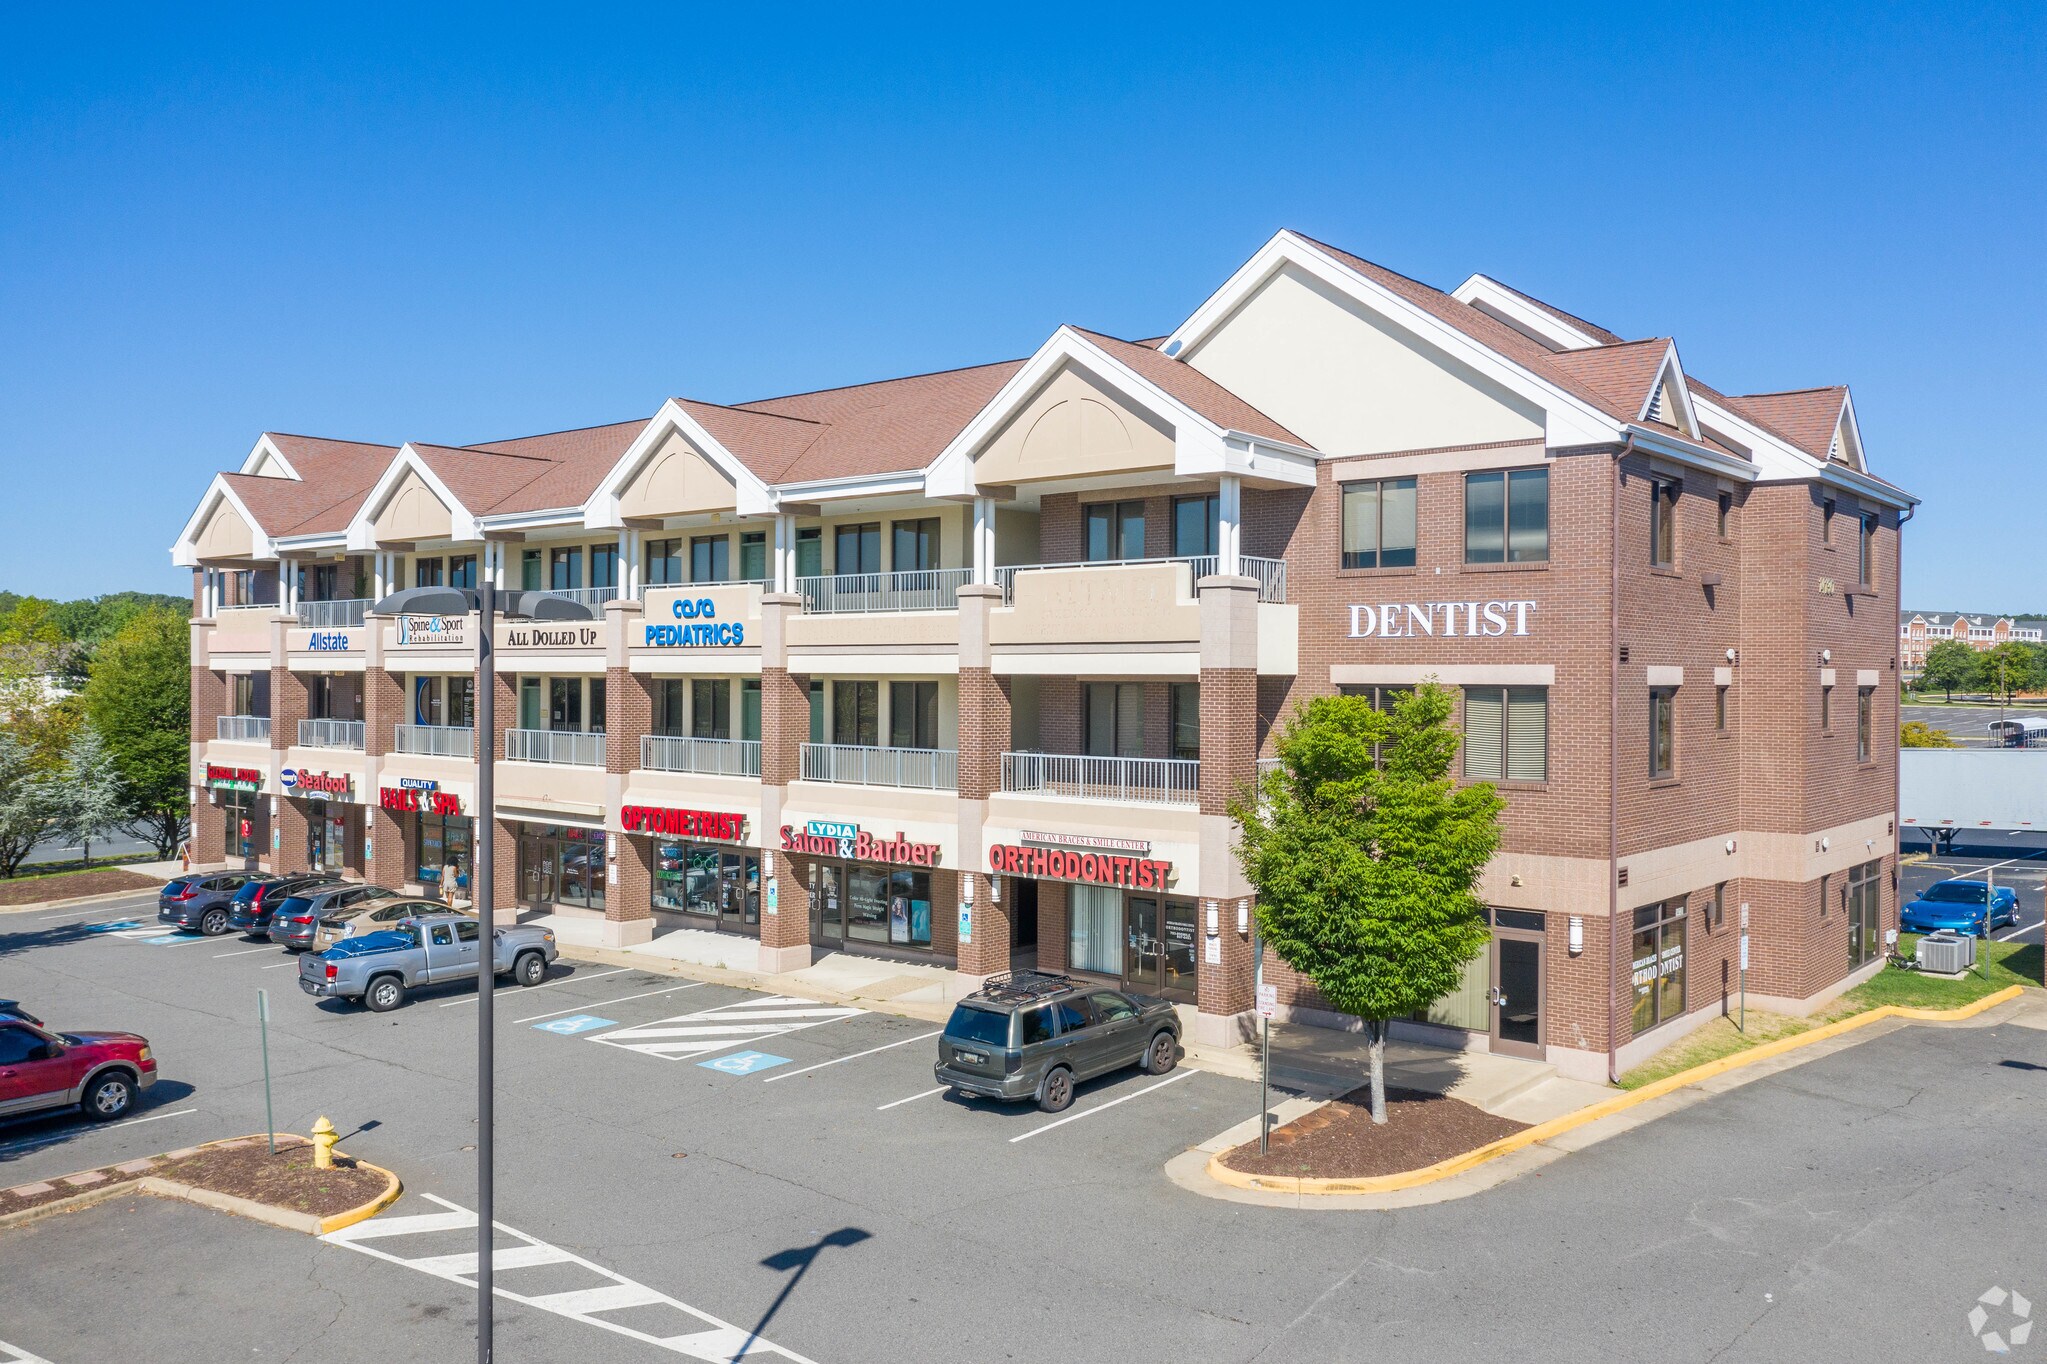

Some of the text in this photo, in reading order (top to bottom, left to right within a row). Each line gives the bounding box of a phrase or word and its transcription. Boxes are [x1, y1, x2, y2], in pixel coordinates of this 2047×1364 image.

[409, 617, 430, 635] Spine
[441, 617, 464, 634] Sport
[1347, 600, 1536, 637] DENTIST
[309, 632, 348, 650] Allstate
[409, 634, 464, 643] Rehabilitation
[507, 628, 597, 646] ALL DOLLED UP
[645, 623, 744, 647] PEDIATRICS
[298, 769, 347, 793] Seafood
[402, 779, 433, 789] QUALITY
[380, 787, 459, 816] NAILS & SPA
[621, 805, 744, 840] OPTOMETRIST
[809, 822, 855, 838] LYDIA
[780, 825, 938, 865] Salon & Barber
[1021, 832, 1145, 850] AMERICAN BRACES & SMILE CENTER
[989, 843, 1169, 889] ORTHODONTIST
